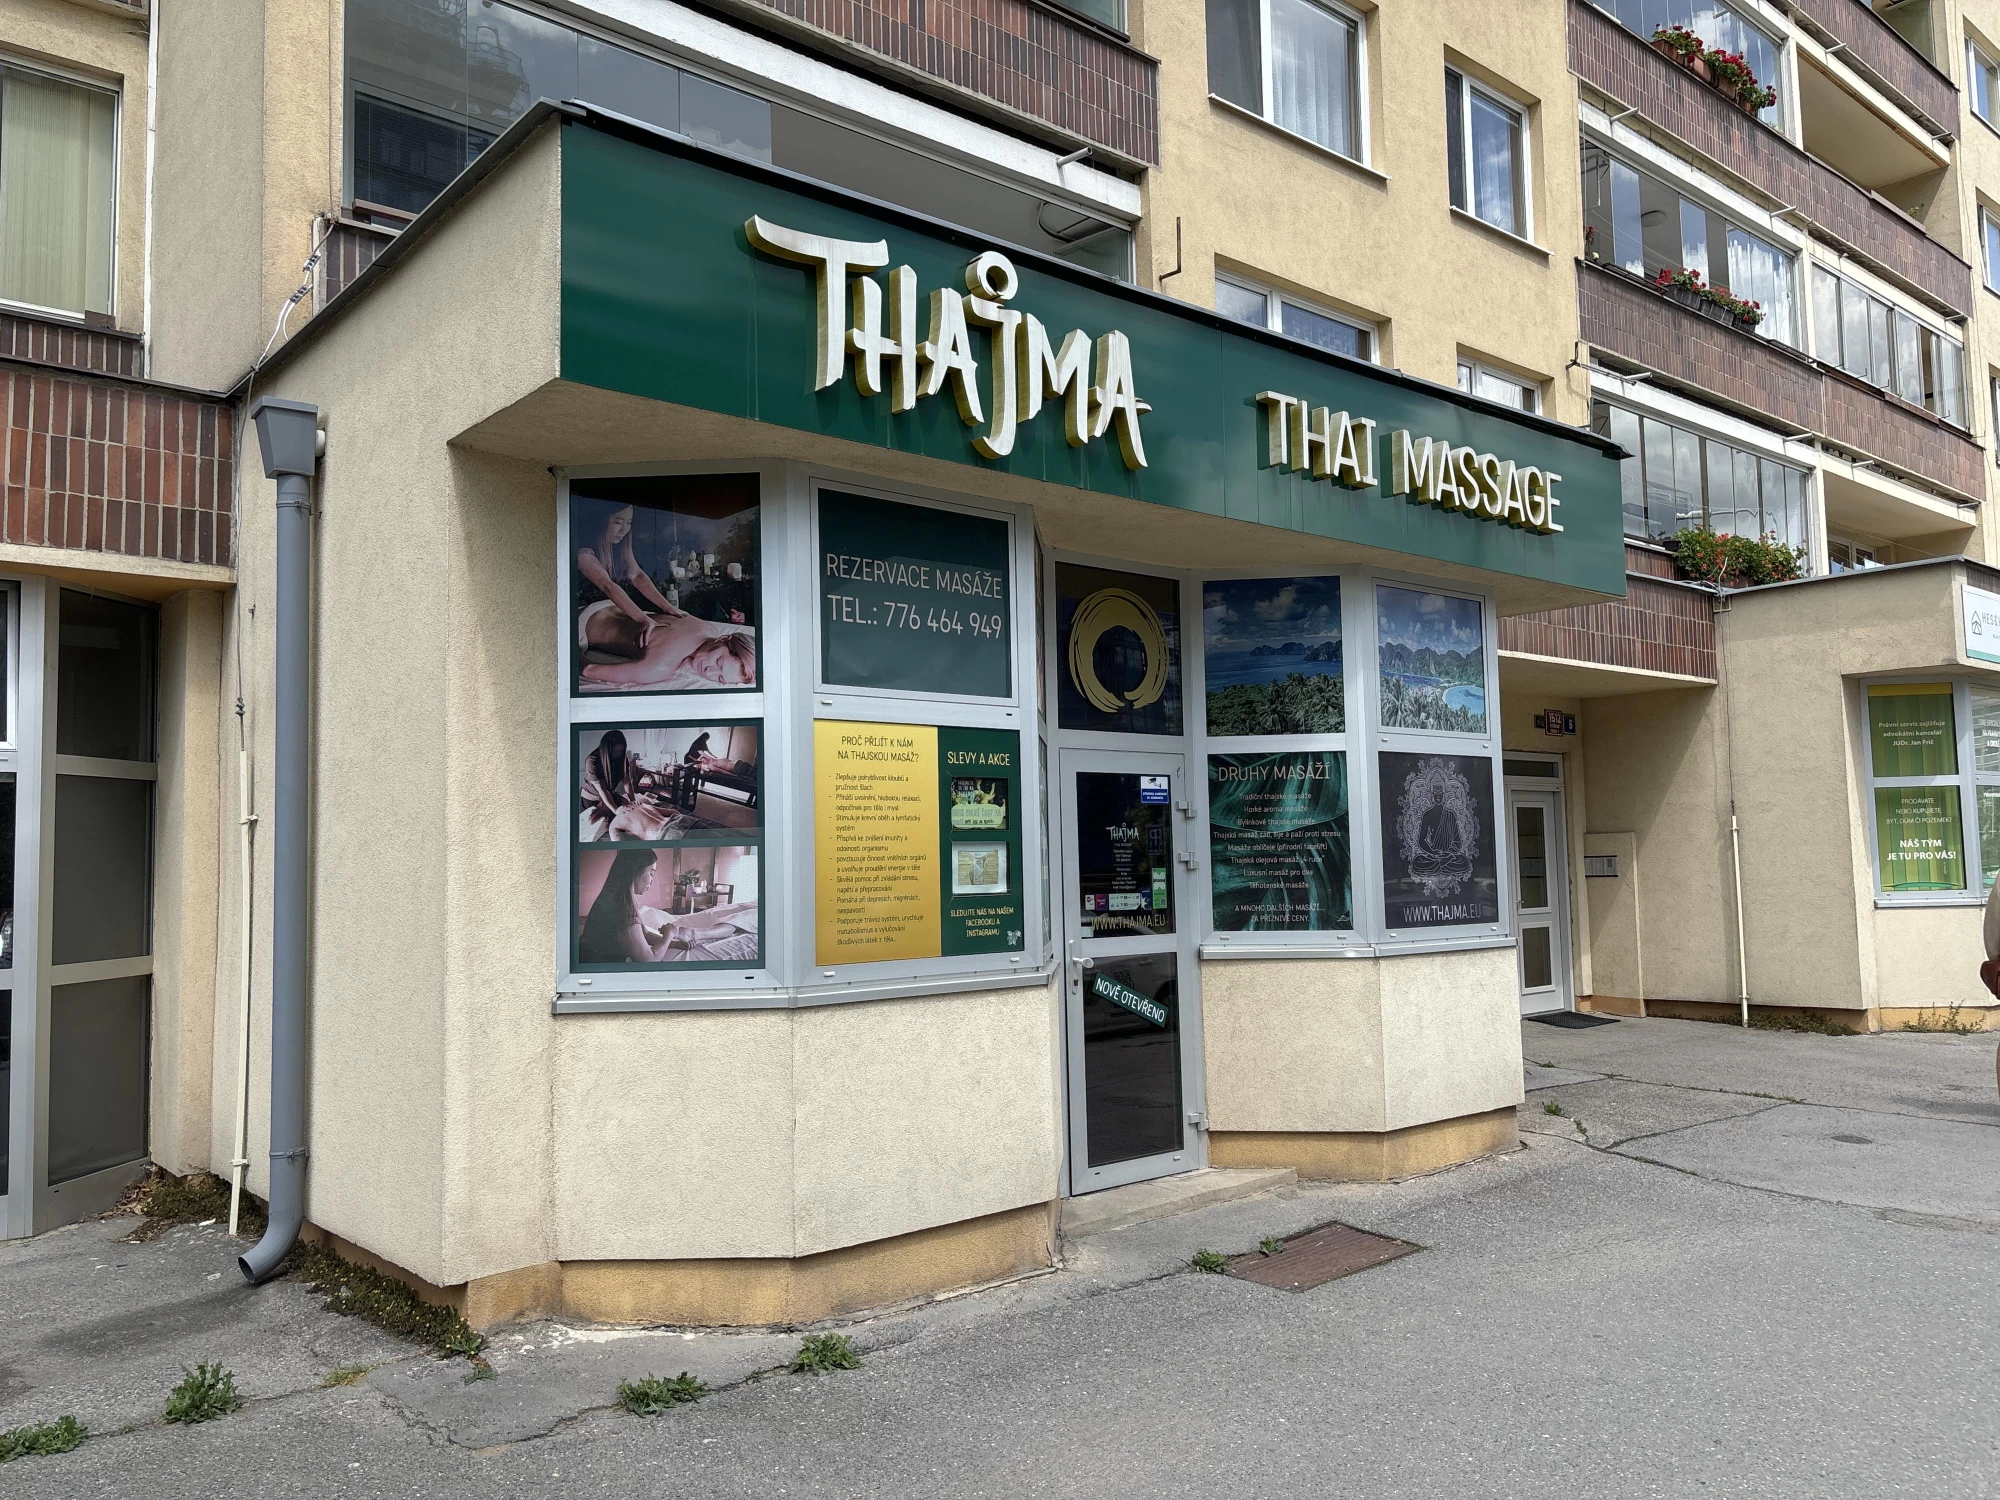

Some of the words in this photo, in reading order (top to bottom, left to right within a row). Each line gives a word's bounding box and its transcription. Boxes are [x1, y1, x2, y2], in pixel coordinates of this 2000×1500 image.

[744, 214, 1152, 471] THAJMA
[1256, 391, 1378, 488] THAI
[1392, 429, 1564, 534] MASSAGE
[827, 554, 930, 589] REZERVACE
[936, 569, 1002, 599] MASÁŽE
[827, 594, 878, 626] TEL.:
[884, 601, 921, 629] 776
[927, 608, 963, 634] 464
[970, 612, 1001, 639] 949
[1569, 720, 1573, 730] 6
[842, 735, 862, 746] PROČ
[865, 736, 888, 747] PŘIJÍT
[890, 739, 895, 747] K
[897, 737, 913, 748] NÁM
[838, 750, 849, 760] NA
[851, 751, 889, 761] THAJSKOU
[891, 751, 919, 762] MASÁŽ?
[948, 751, 977, 765] SLEVY
[979, 753, 986, 765] A
[988, 753, 1010, 766] AKCE
[835, 773, 857, 782] Zlepšuje
[1218, 766, 1270, 782] DRUHY
[1274, 762, 1331, 780] MASÁŽÍ
[836, 784, 858, 792] pružnost
[1238, 819, 1266, 827] Bylinkové
[1105, 823, 1140, 842] THAJMA
[1214, 832, 1237, 840] Thajská
[1253, 843, 1275, 851] obličeje
[1900, 839, 1919, 848] NÁŠ
[1921, 839, 1942, 847] TÝM
[1887, 853, 1897, 861] JE
[1914, 852, 1933, 860] PRO
[1935, 850, 1956, 859] VÁS!
[950, 909, 975, 917] SLEDUJTE
[977, 907, 987, 916] NÁS
[997, 906, 1014, 914] NAŠEM
[1403, 903, 1482, 923] WWW.THAJMA.EU
[966, 919, 996, 927] FACEBOOKU
[1092, 914, 1166, 930] WWW.THAJMA.EU
[1251, 915, 1259, 923] ZA
[967, 929, 1000, 937] INSTAGRAMU
[1096, 978, 1121, 1000] NOVĚ
[1121, 991, 1164, 1022] OTEVŘENO
